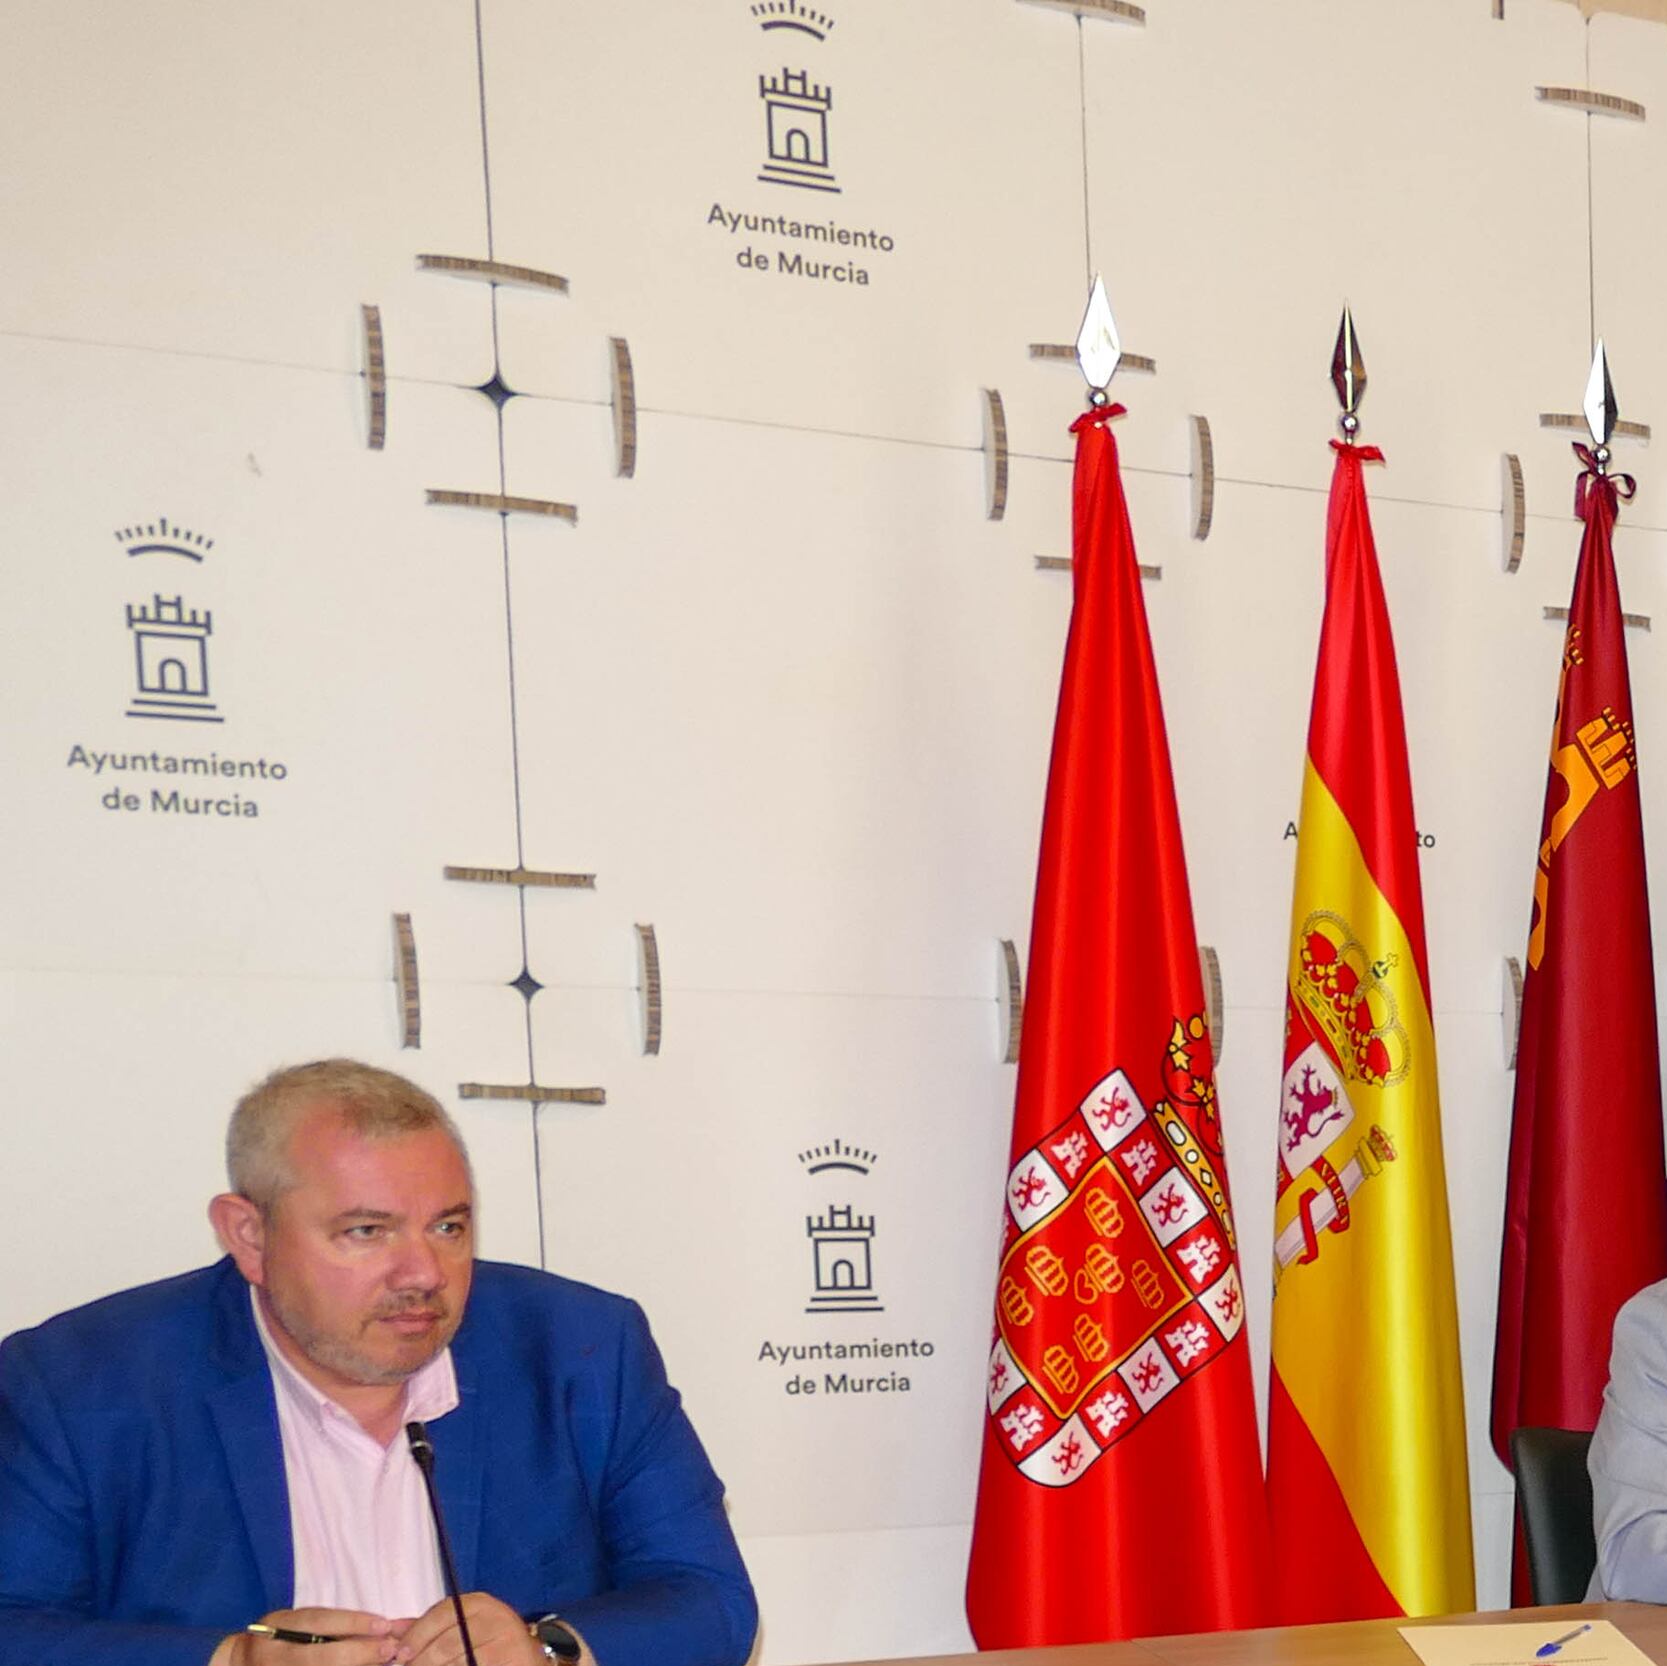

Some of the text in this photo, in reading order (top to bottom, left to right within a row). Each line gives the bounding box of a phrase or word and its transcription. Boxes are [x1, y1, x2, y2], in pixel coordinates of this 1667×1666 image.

[708, 204, 894, 254] Ayuntamiento
[737, 246, 870, 288] de Murcia
[68, 744, 288, 784] Ayuntamiento
[102, 786, 259, 819] de Murcia
[758, 1338, 935, 1365] Ayuntamiento
[785, 1371, 911, 1395] de Murcia
